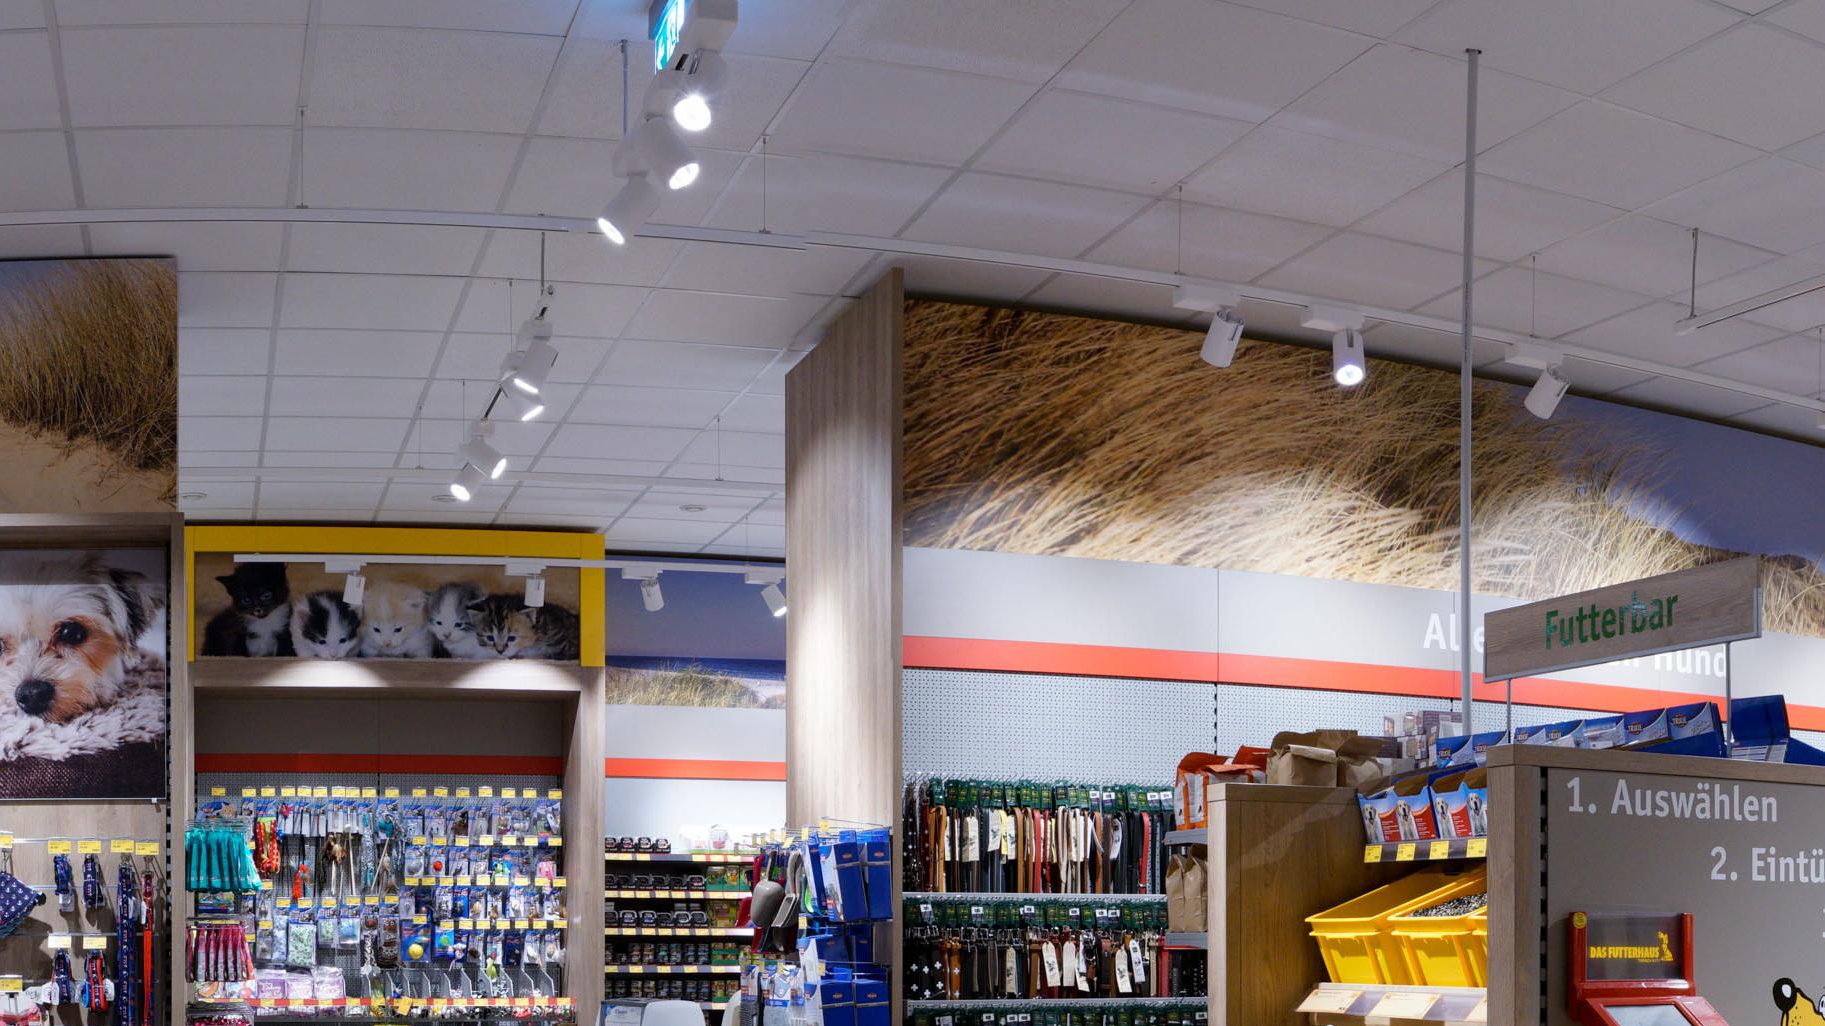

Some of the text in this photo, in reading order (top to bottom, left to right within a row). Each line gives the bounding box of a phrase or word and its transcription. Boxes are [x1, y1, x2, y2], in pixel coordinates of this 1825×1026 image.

[1545, 591, 1678, 650] Futterbar
[1566, 777, 1777, 822] 1. Auswählen
[1710, 847, 1738, 881] 2.
[1590, 947, 1660, 959] DAS FUTTERHAUS
